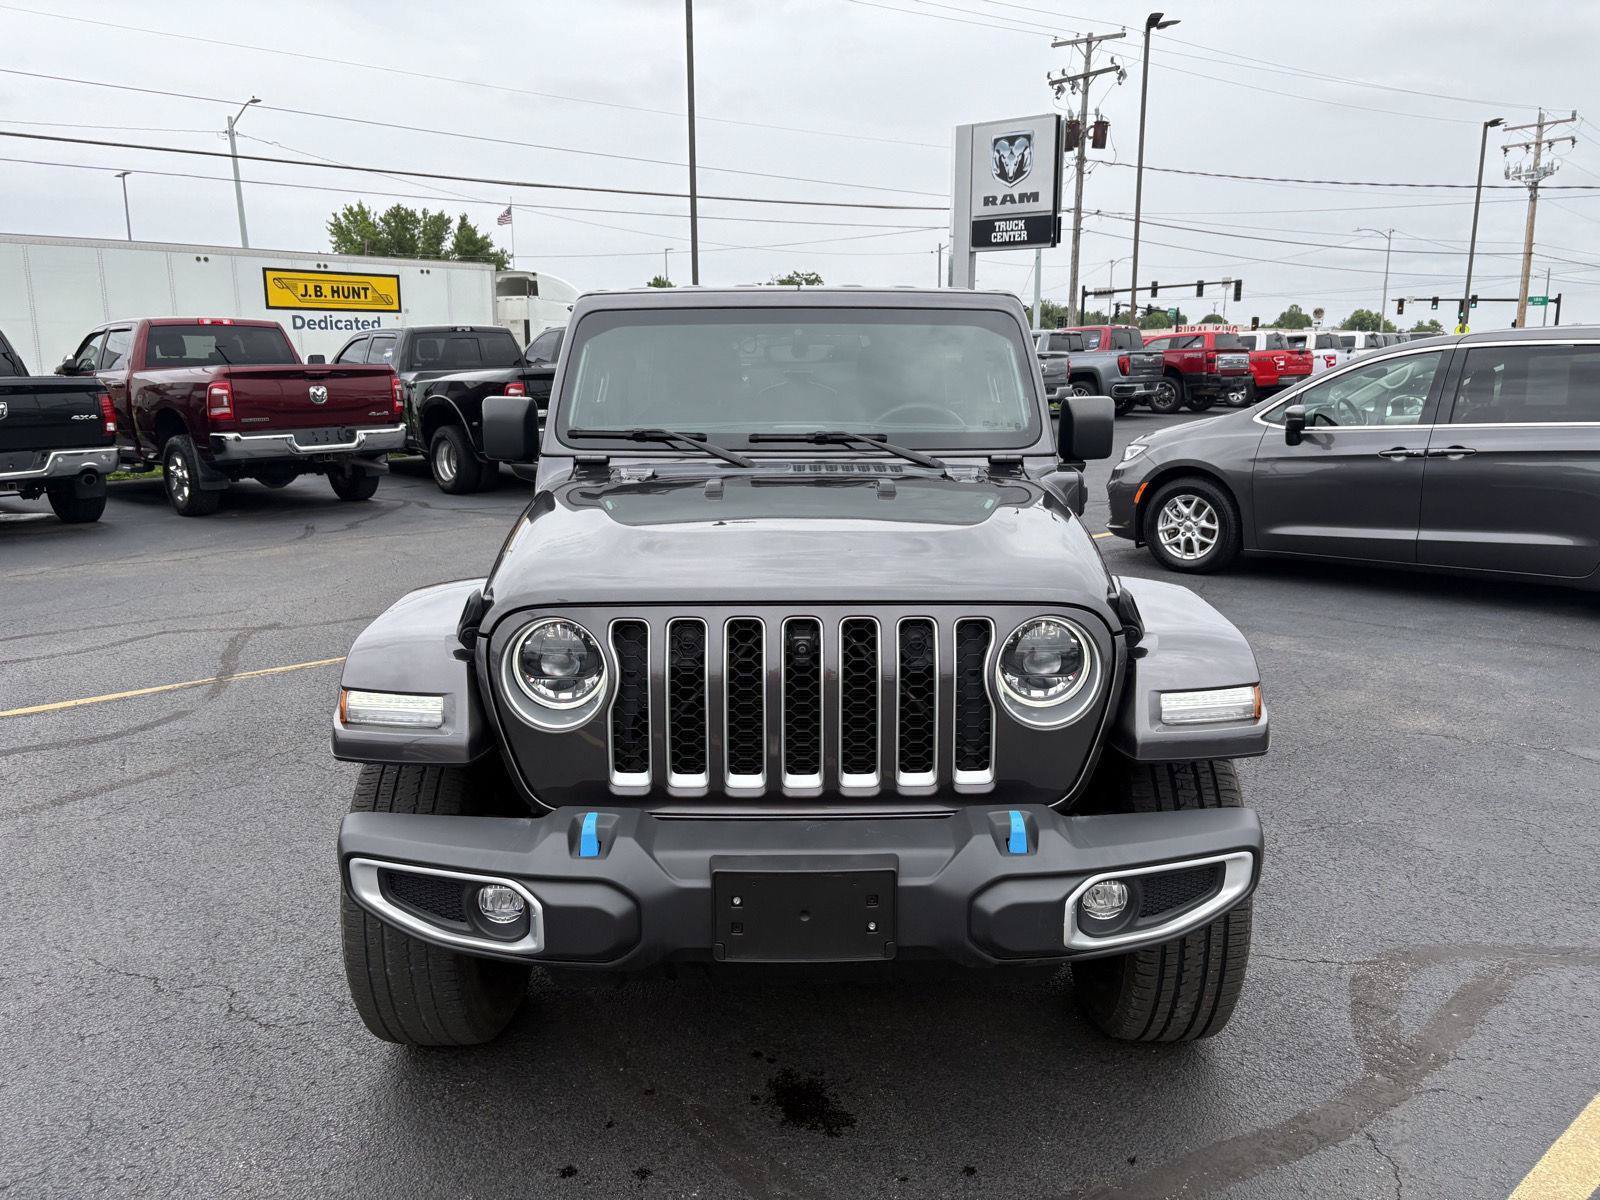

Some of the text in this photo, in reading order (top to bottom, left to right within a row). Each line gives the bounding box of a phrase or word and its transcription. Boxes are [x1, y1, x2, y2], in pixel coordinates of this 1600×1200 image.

[983, 192, 1039, 206] RAM
[994, 219, 1026, 232] TRUCK
[991, 230, 1028, 243] CENTER
[331, 286, 370, 300] HUNT
[292, 314, 381, 330] Dedicated
